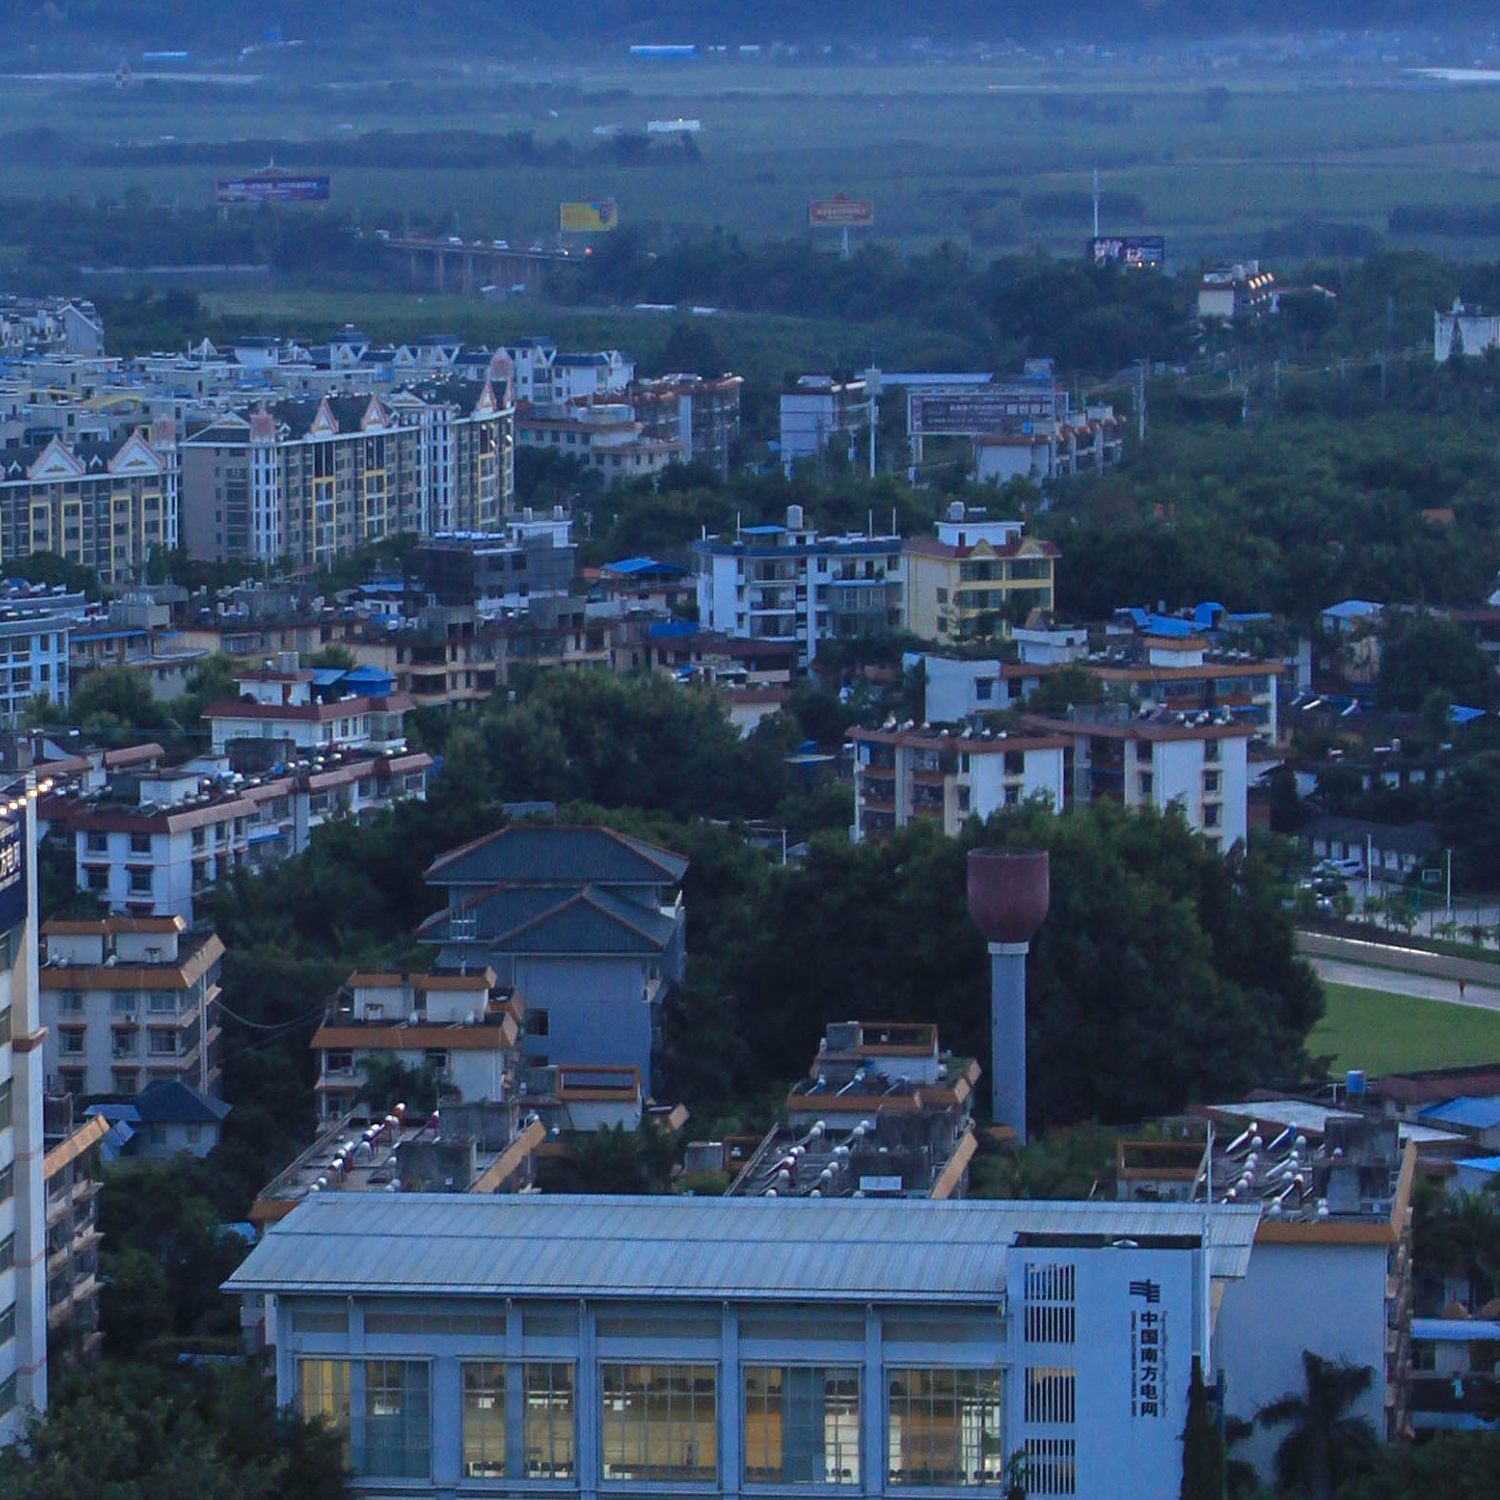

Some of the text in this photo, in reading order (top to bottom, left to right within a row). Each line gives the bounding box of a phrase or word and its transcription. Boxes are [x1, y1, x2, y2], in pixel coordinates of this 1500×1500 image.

[1141, 1310, 1158, 1417] 中国南方电网
